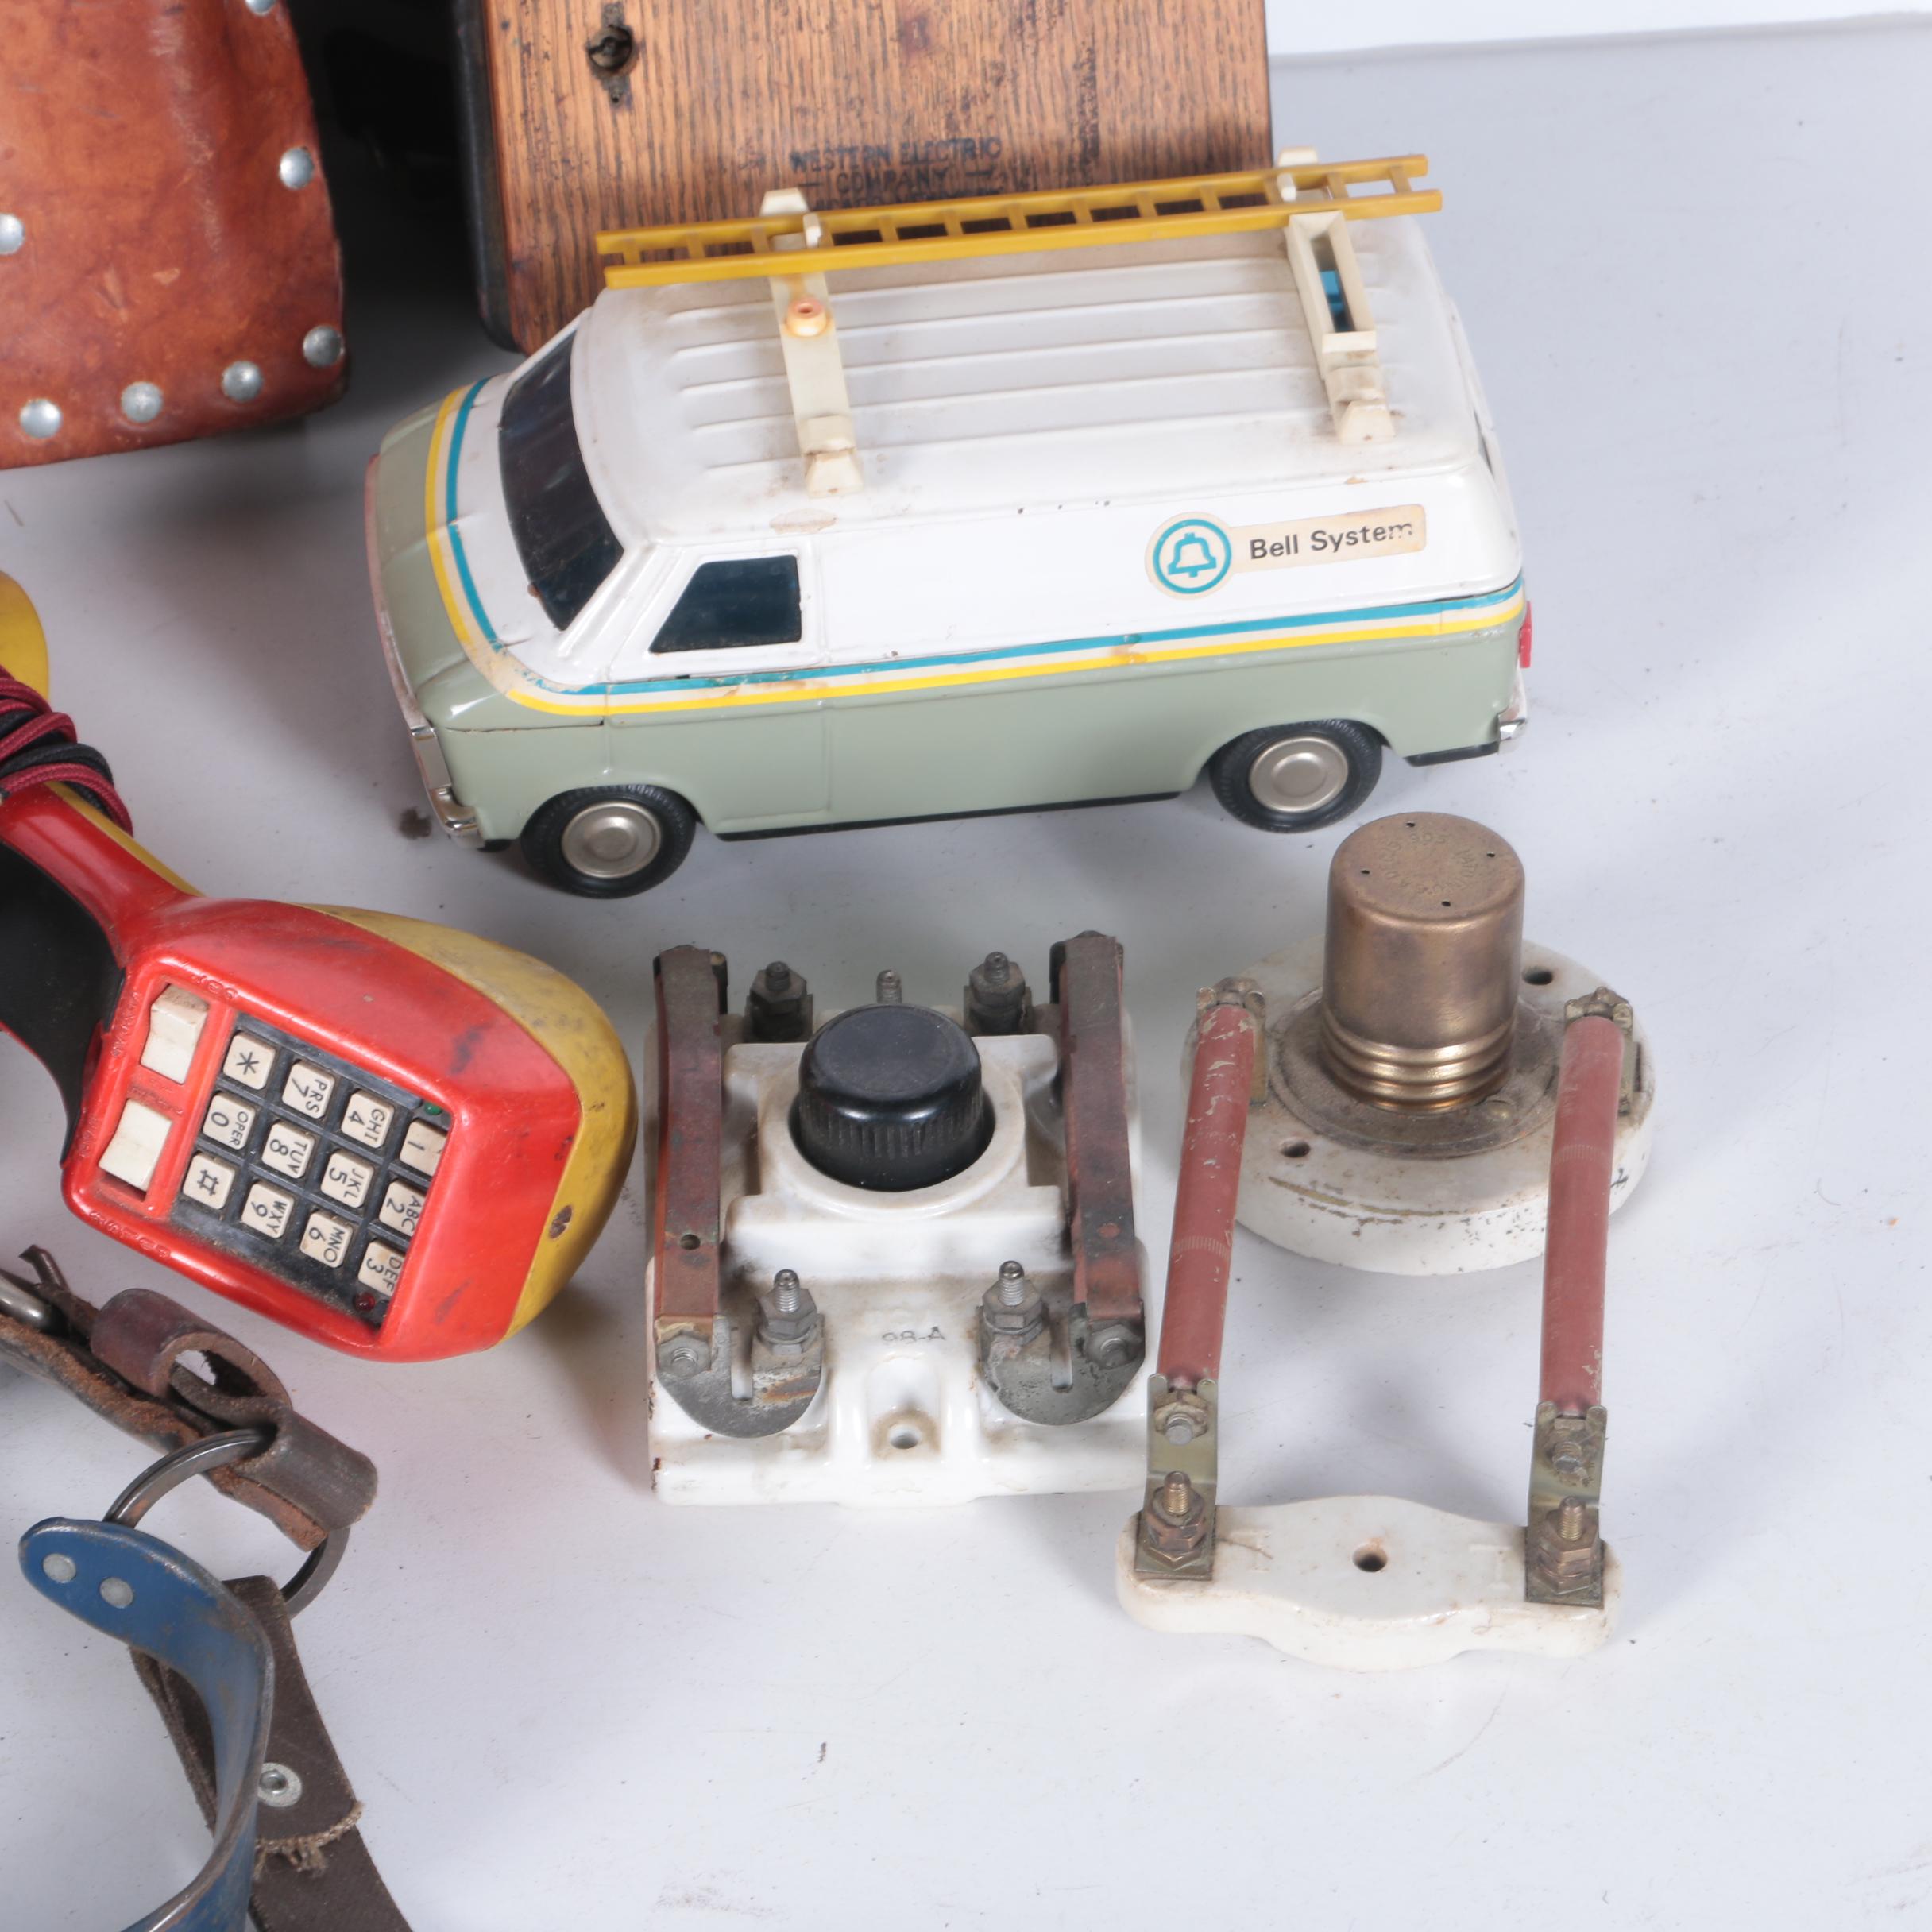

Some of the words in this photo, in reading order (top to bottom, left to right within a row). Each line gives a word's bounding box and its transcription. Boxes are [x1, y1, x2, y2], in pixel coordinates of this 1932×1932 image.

[836, 167, 948, 193] COMPANY
[1250, 535, 1299, 559] Bell
[1310, 522, 1412, 552] System
[291, 1079, 310, 1098] 7
[306, 1079, 326, 1112] PRS
[228, 1111, 248, 1146] OPER
[349, 1111, 365, 1125] 4
[365, 1108, 385, 1143] GHI
[269, 1139, 288, 1155] 8
[287, 1141, 307, 1173] TUV
[329, 1167, 347, 1182] 5
[343, 1168, 365, 1198] JKL
[251, 1200, 267, 1218] 9
[266, 1200, 288, 1234] WXY
[386, 1197, 404, 1214] 2
[401, 1195, 423, 1231] ABC
[310, 1228, 326, 1241] 6
[323, 1227, 346, 1264] MNO
[367, 1258, 384, 1274] 3
[383, 1257, 401, 1292] DEF
